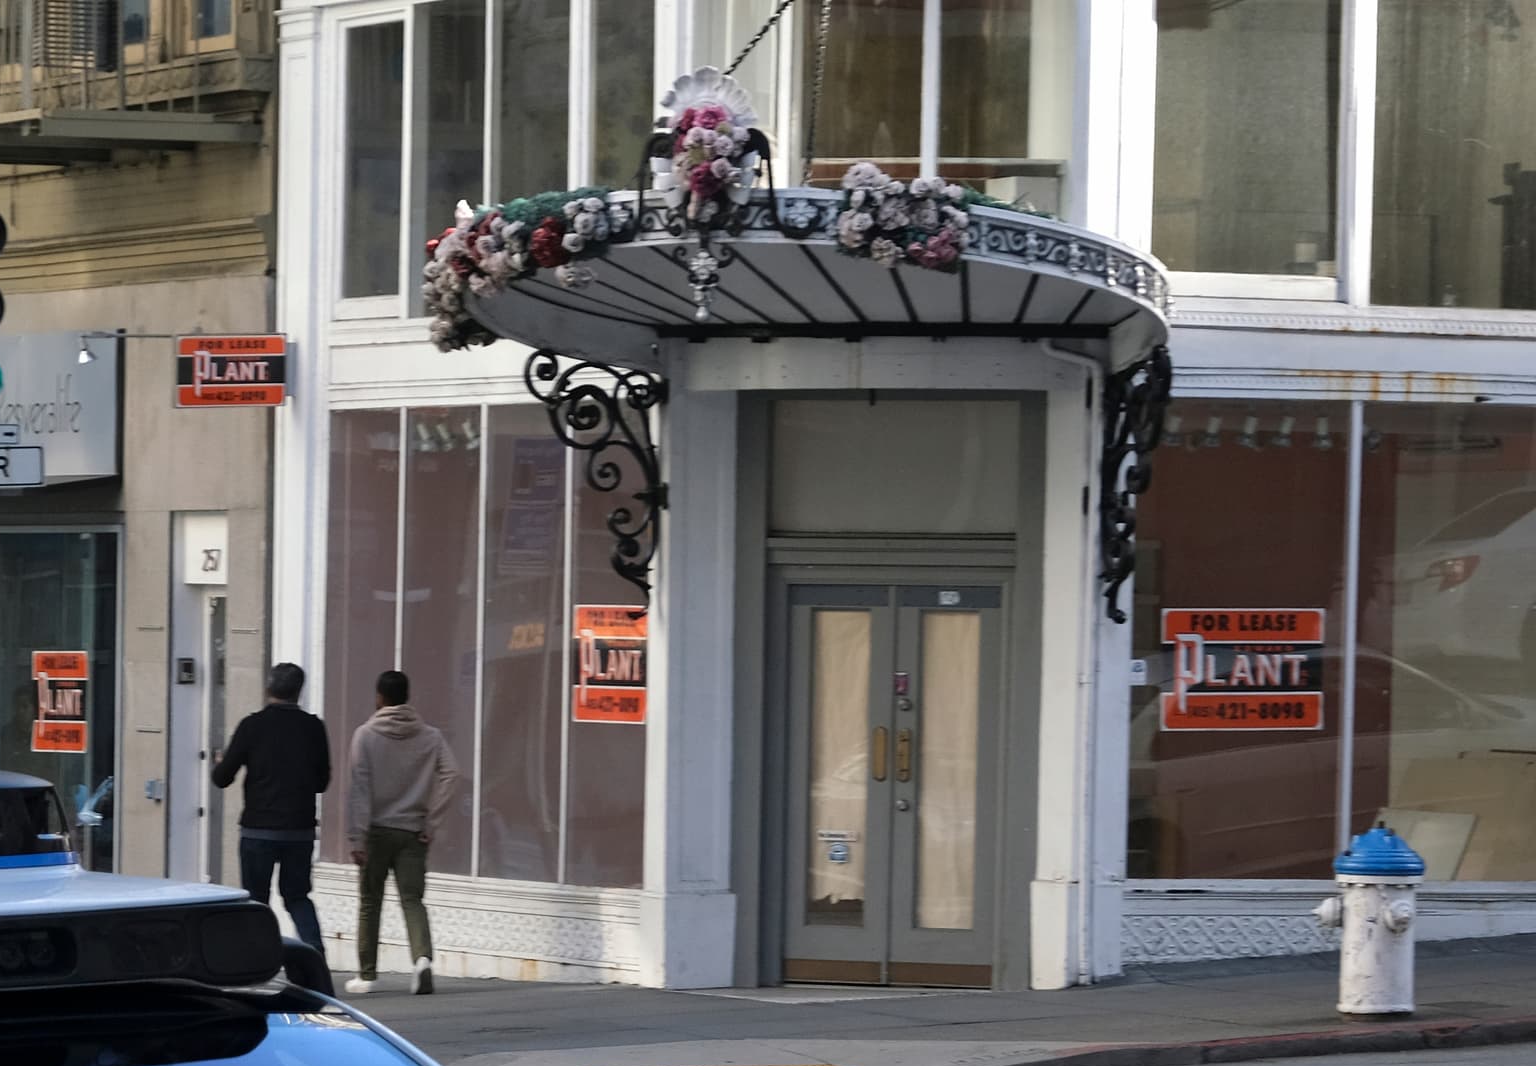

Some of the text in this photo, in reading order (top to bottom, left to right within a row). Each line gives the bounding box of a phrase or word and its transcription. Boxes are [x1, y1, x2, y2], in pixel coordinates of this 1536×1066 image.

[192, 349, 270, 398] PLANT
[1190, 613, 1297, 631] FOR LEASE
[579, 628, 642, 705] PLANT
[1174, 633, 1308, 715] PLANT
[37, 671, 84, 738] PLANT
[1216, 702, 1305, 720] 421-8098
